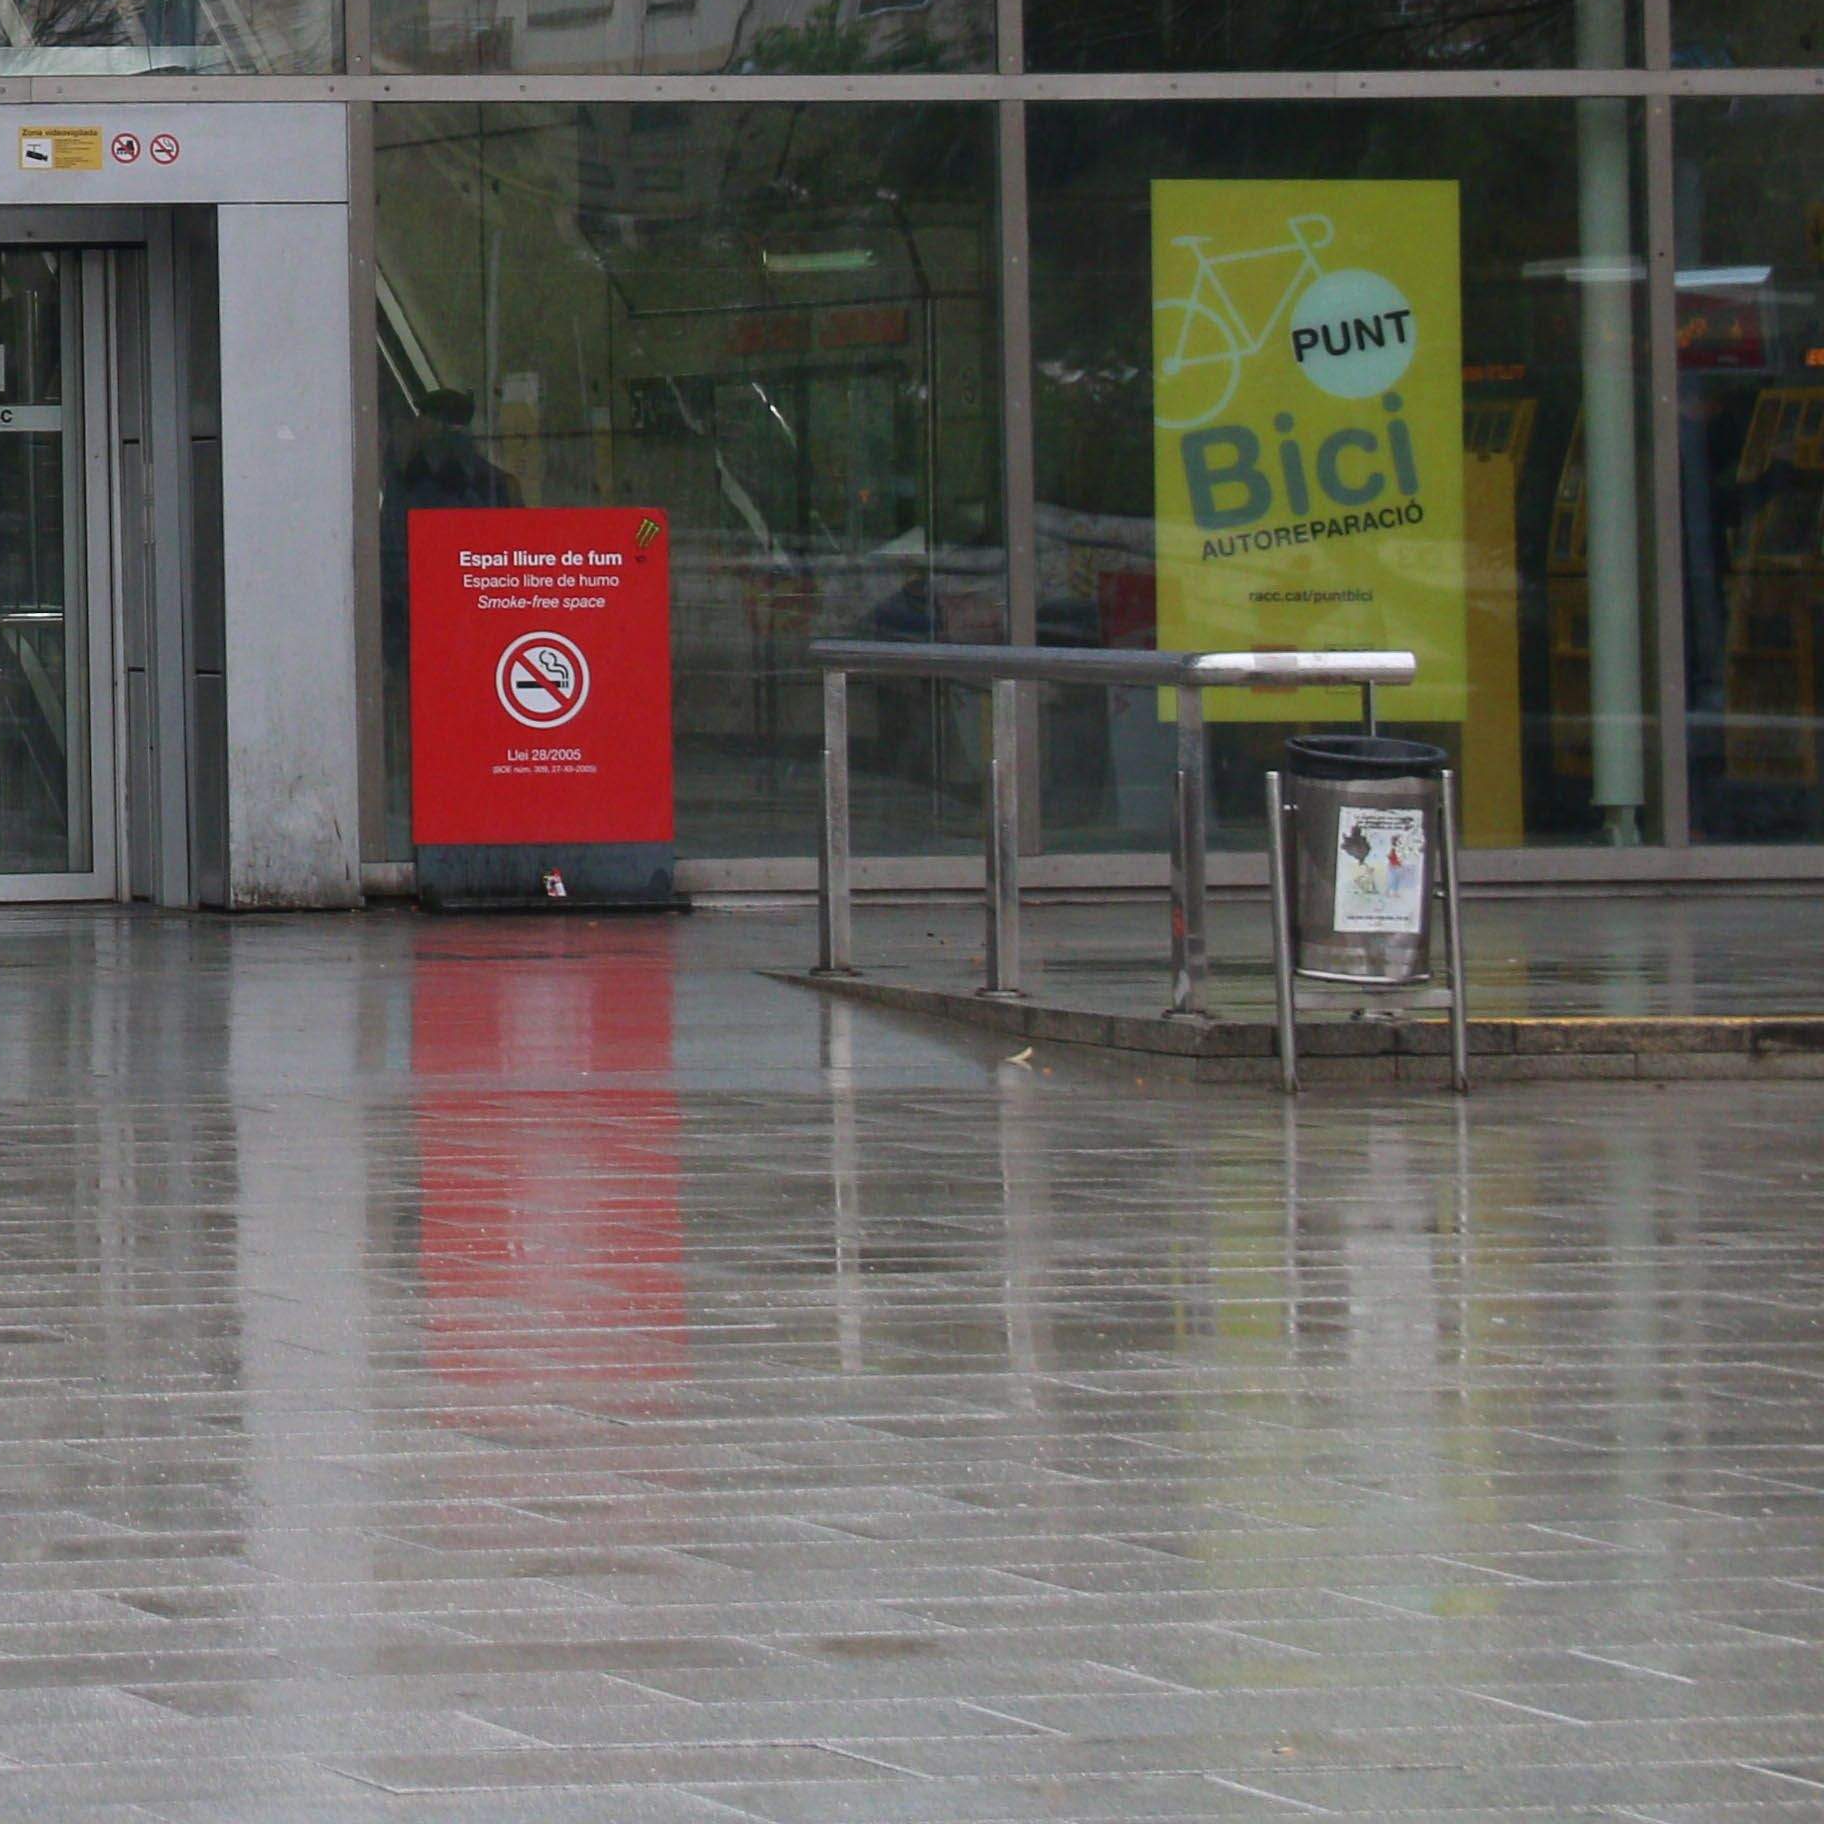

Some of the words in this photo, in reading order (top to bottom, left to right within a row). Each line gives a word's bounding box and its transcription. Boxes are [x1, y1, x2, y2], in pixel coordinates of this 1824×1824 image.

[1291, 308, 1412, 363] PUNT
[1180, 392, 1419, 531] Bici
[1202, 499, 1424, 561] AUTOREPARACIÓ
[459, 551, 508, 569] Espai
[513, 551, 556, 566] lliure
[561, 551, 583, 566] de
[588, 550, 623, 566] fum
[463, 574, 520, 590] Espacio
[523, 574, 554, 587] libre
[557, 574, 576, 587] de
[579, 574, 620, 587] humo
[477, 595, 559, 609] Smoke-free
[562, 596, 606, 611] space
[1249, 588, 1374, 604] racc.cat/puntbici
[507, 748, 529, 761] Llei
[532, 748, 582, 761] 28/2005
